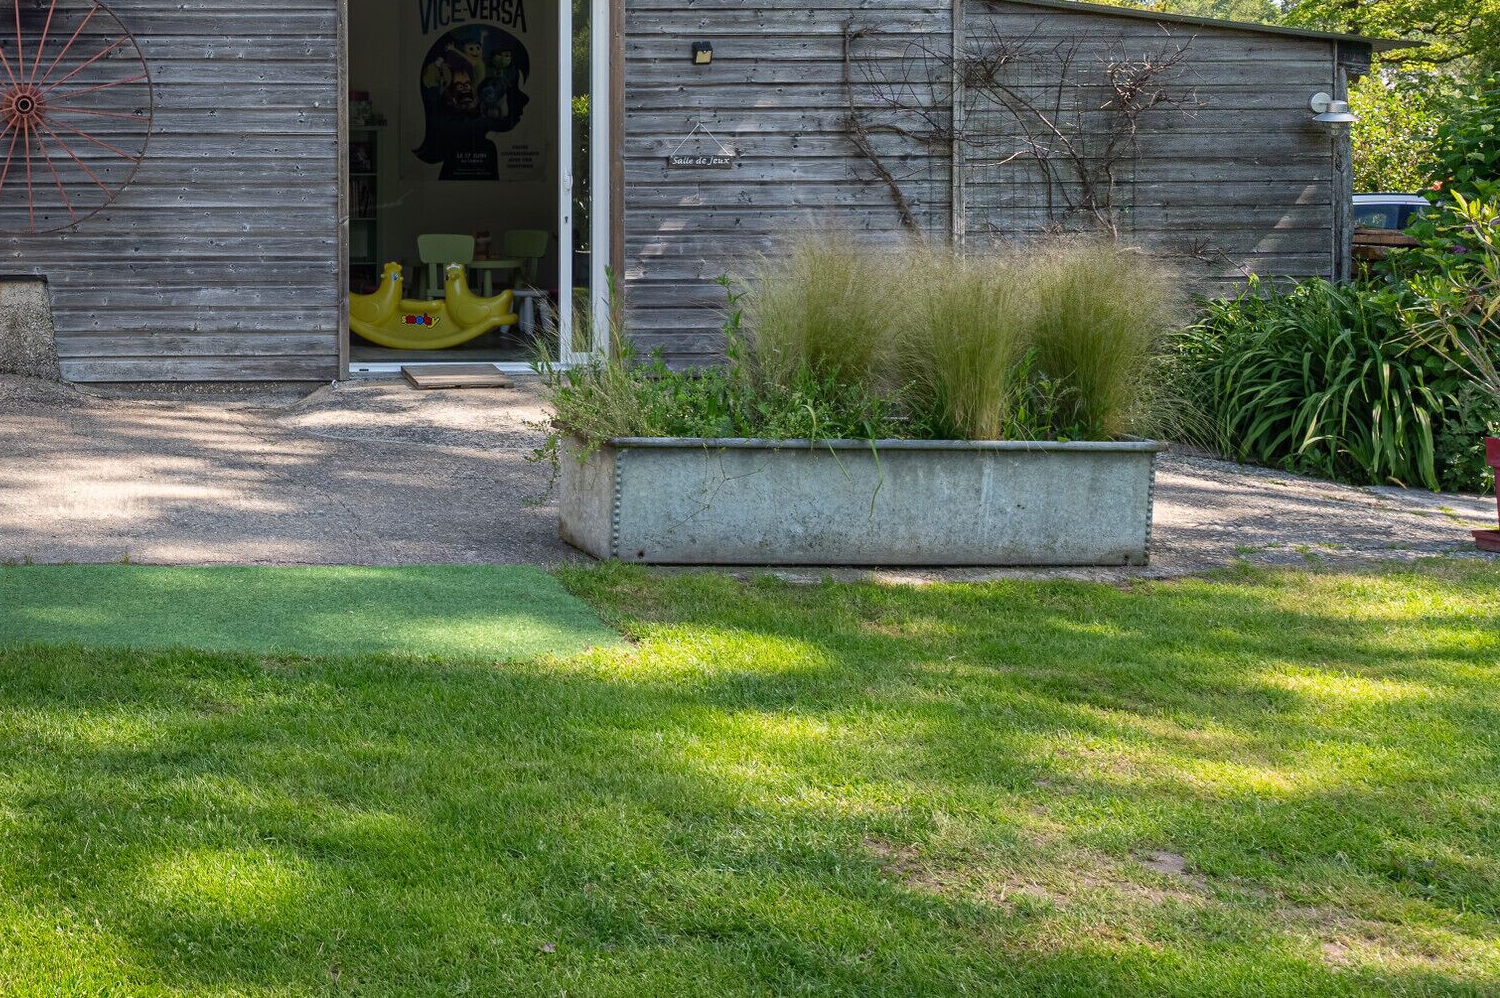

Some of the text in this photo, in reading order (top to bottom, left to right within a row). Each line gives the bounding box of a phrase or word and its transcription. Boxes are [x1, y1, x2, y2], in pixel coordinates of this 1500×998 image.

[672, 156, 694, 165] Salle
[695, 156, 707, 165] de
[401, 313, 440, 329] smoby
